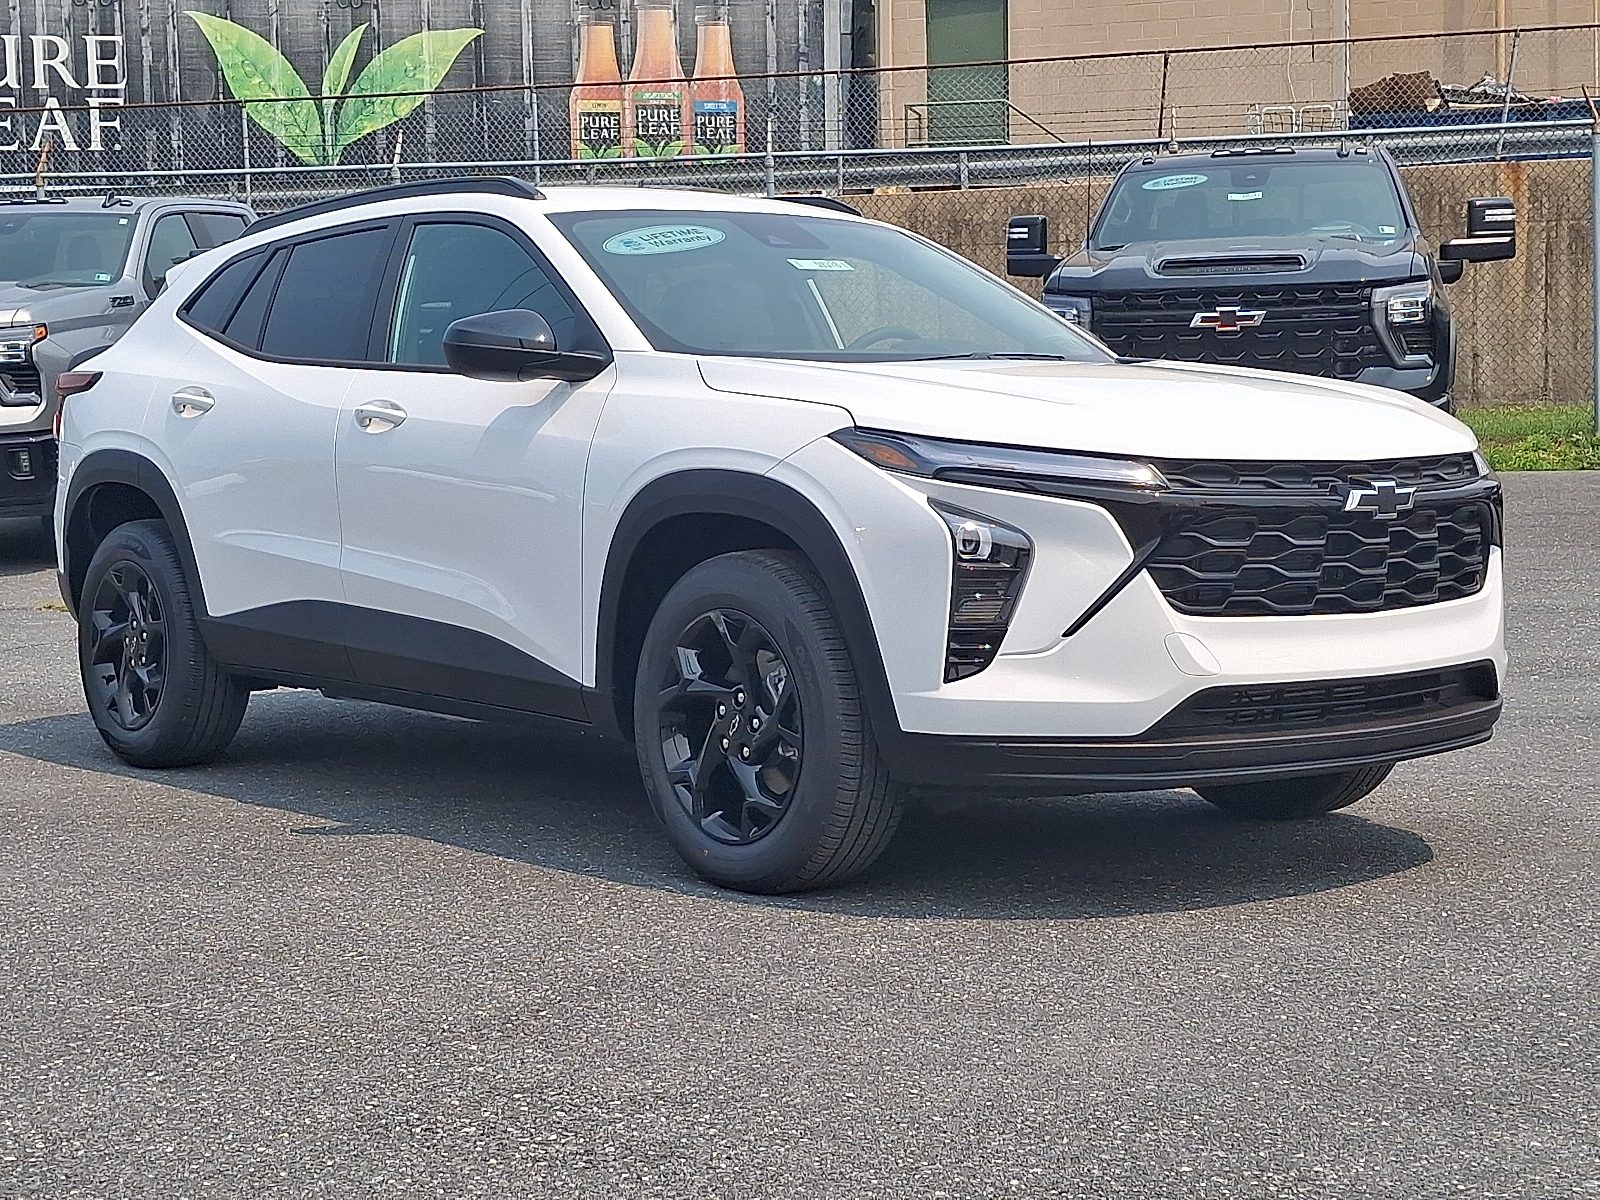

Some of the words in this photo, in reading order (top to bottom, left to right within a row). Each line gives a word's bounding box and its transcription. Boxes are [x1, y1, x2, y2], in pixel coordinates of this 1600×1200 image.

[638, 109, 680, 121] PURE
[581, 116, 619, 128] PURE
[697, 116, 735, 127] PURE
[639, 228, 704, 242] LIFETIME
[648, 235, 712, 248] Warranty
